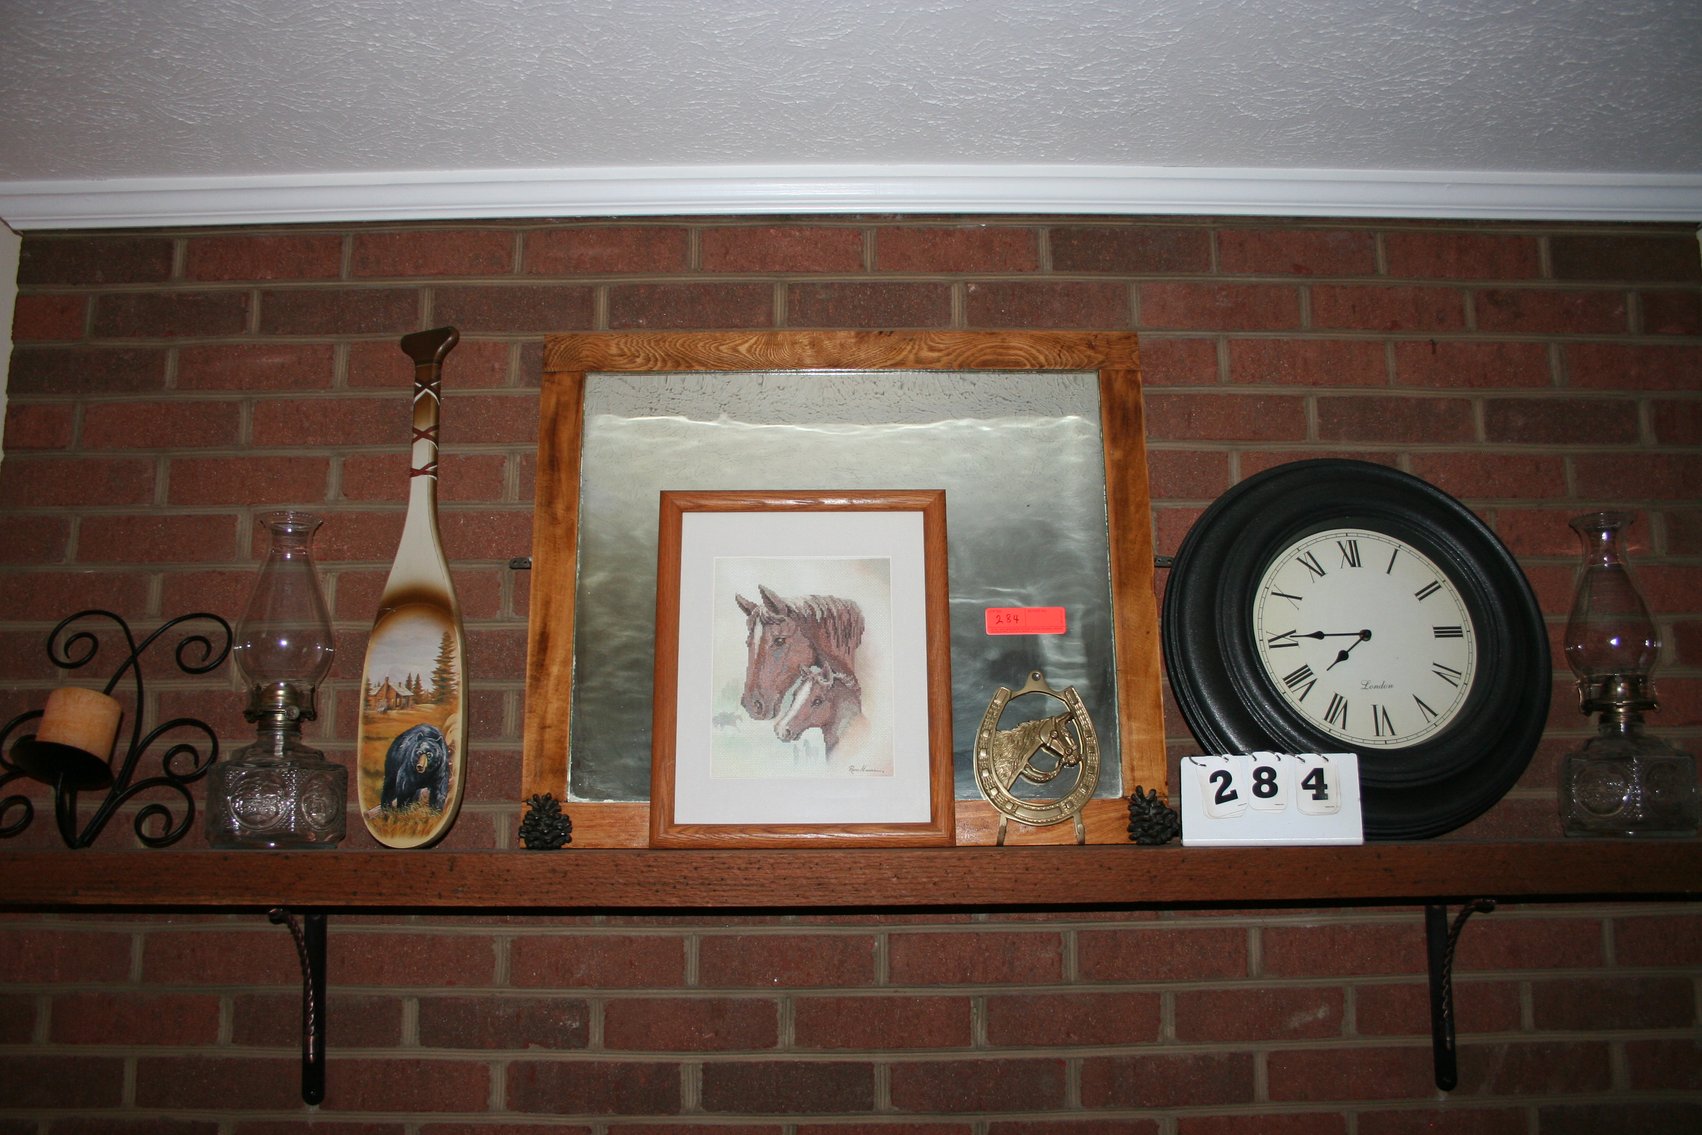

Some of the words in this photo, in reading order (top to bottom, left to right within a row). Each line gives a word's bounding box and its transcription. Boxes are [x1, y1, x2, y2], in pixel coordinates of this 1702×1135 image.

[1296, 550, 1328, 584] XI
[1336, 539, 1364, 569] XII
[1385, 547, 1399, 575] I
[1270, 583, 1303, 611] X
[1413, 579, 1442, 602] II
[995, 613, 1020, 625] 284
[1432, 625, 1464, 639] III
[1266, 629, 1300, 650] IX
[1282, 664, 1318, 703] VIII
[1360, 679, 1395, 691] London
[1431, 662, 1462, 688] IV
[1323, 692, 1349, 730] VII
[1370, 703, 1398, 737] VI
[1411, 693, 1439, 724] V
